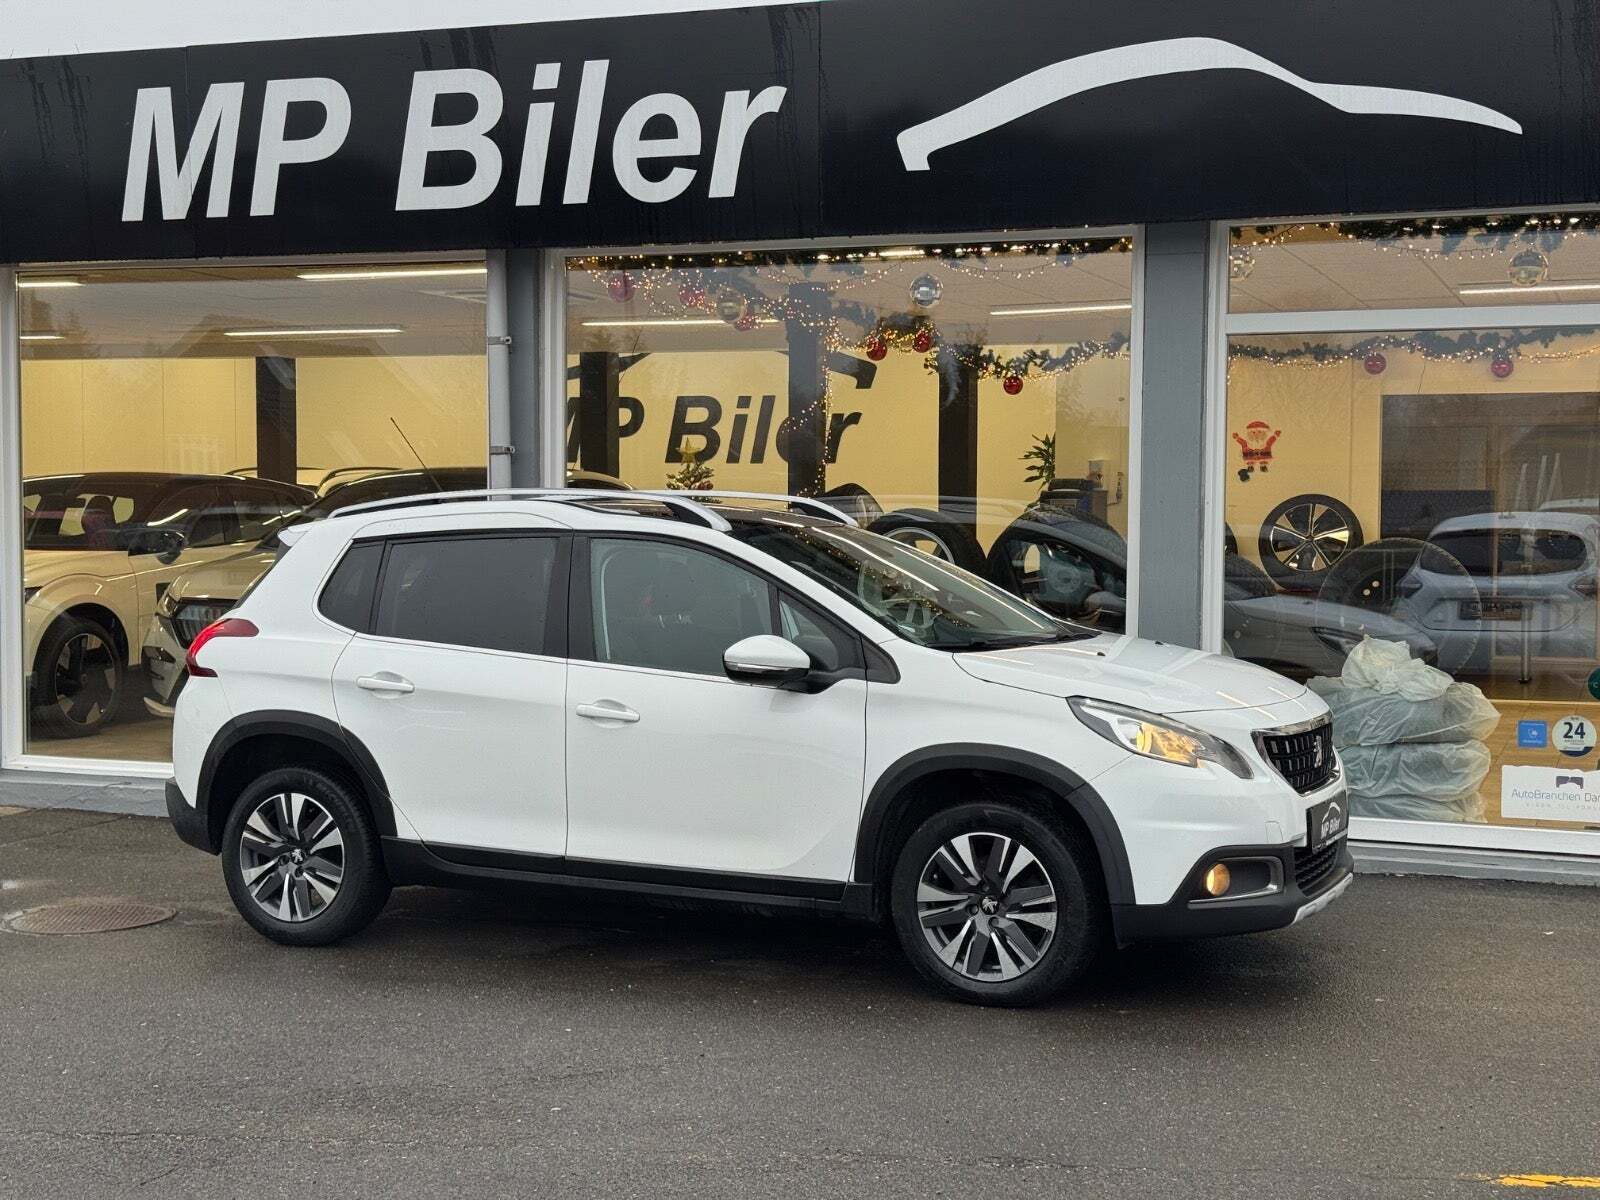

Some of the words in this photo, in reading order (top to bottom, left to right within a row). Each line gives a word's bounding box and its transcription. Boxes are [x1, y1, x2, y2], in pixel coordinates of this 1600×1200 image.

[121, 77, 351, 222] MP
[394, 58, 788, 212] Biler
[1563, 721, 1586, 739] 24
[1511, 788, 1581, 801] AutoBranchen
